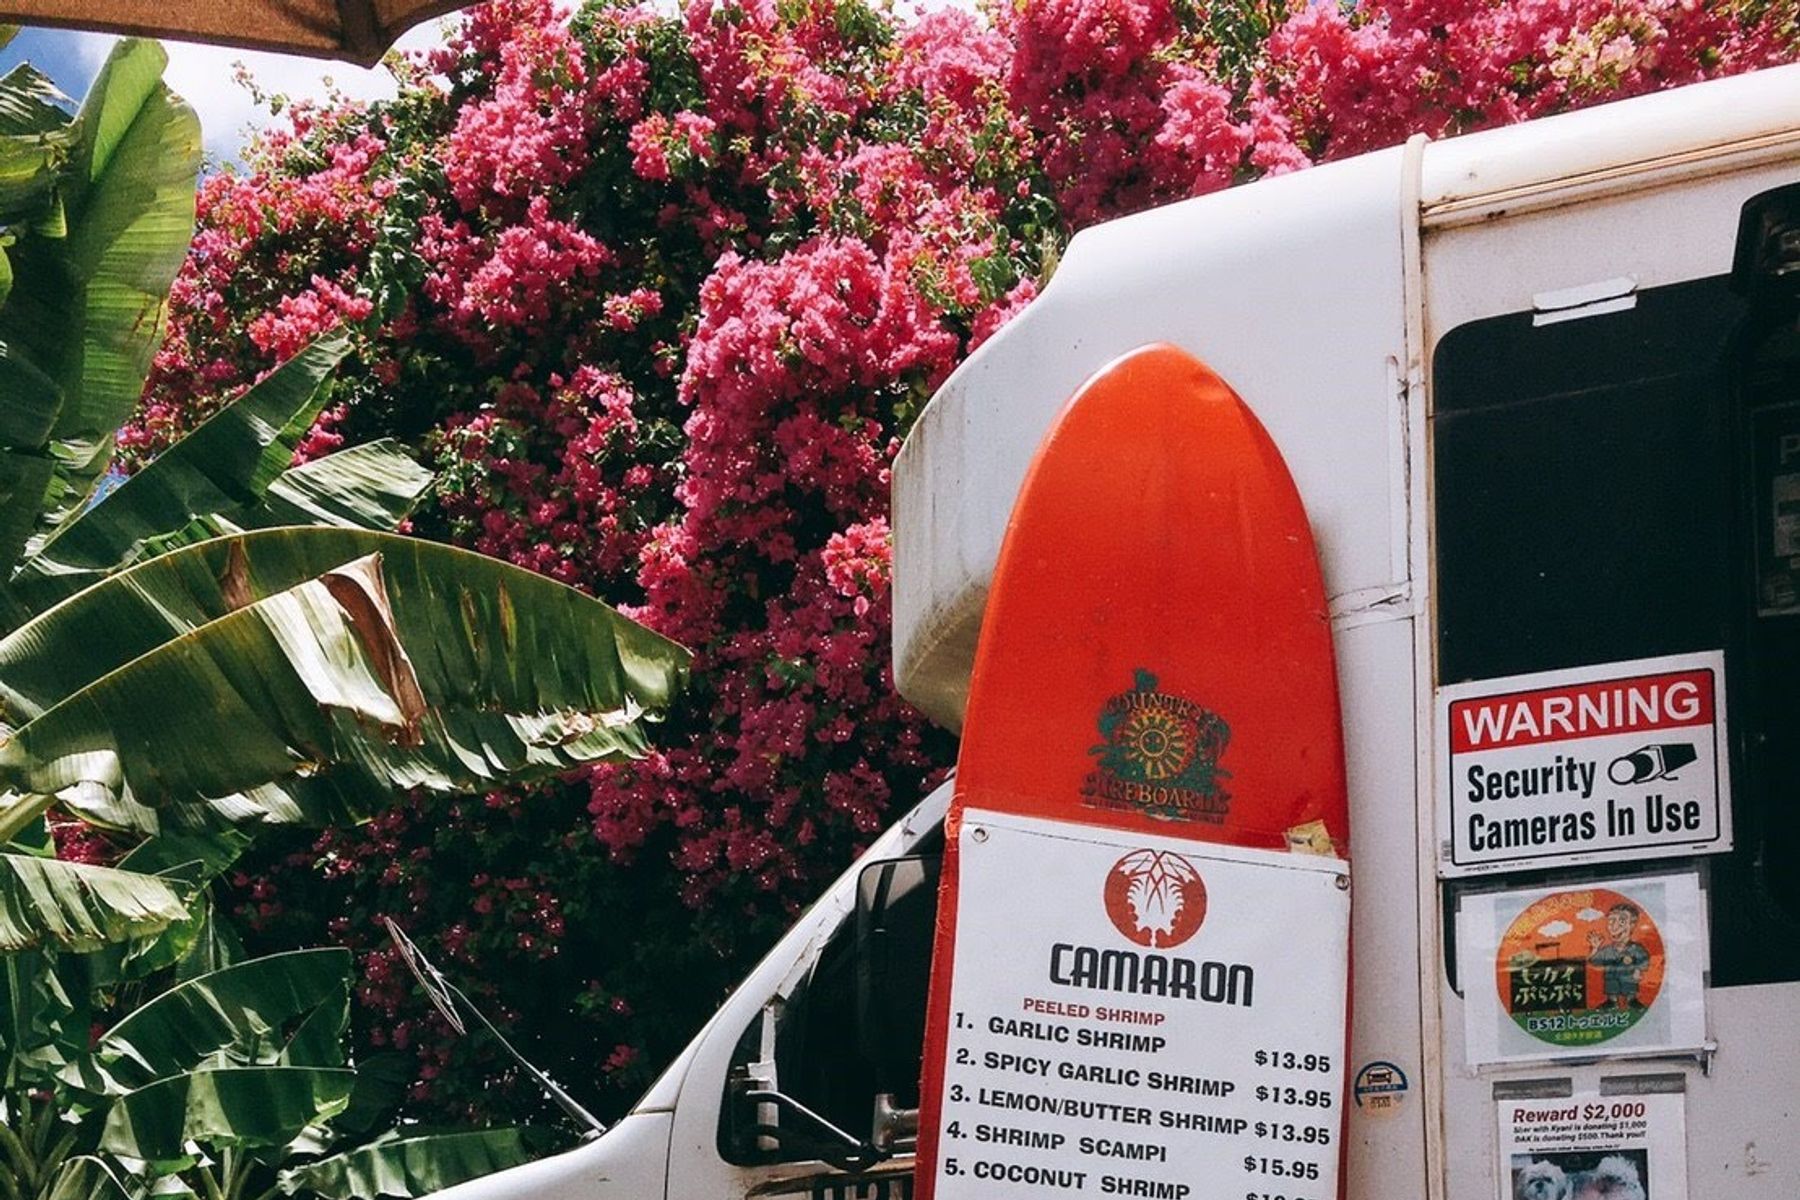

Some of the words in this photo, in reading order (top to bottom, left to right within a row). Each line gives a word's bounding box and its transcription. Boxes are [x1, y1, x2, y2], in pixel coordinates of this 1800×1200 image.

[1462, 681, 1700, 745] WARNING
[1467, 755, 1596, 803] Security
[1468, 808, 1596, 852] Cameras
[1607, 799, 1635, 838] In
[1646, 794, 1700, 834] Use
[1049, 942, 1254, 1006] CAMARON
[1023, 998, 1090, 1018] PEELED
[1095, 1007, 1166, 1027] SHRIMP
[1528, 1016, 1565, 1031] BS12
[954, 1012, 973, 1030] 1.
[988, 1016, 1069, 1043] GARLIC
[1077, 1028, 1166, 1053] SHRIMP
[1254, 1049, 1331, 1074] $13.95
[956, 1048, 976, 1067] 2.
[984, 1051, 1051, 1077] SPICY
[1058, 1062, 1140, 1088] GARLIC
[1147, 1072, 1235, 1099] SHRIMP
[1255, 1084, 1332, 1109] $13.95
[950, 1084, 971, 1103] 3.
[978, 1087, 1152, 1125] LEMON/BUTTER
[1159, 1110, 1248, 1136] SHRIMP
[1254, 1121, 1330, 1146] $13.95
[1512, 1105, 1579, 1123] Reward
[1583, 1102, 1646, 1121] $2,000
[1541, 1133, 1576, 1143] donating
[1583, 1122, 1618, 1132] donating
[944, 1158, 966, 1177] 5.
[973, 1161, 1087, 1191] COCONUT
[946, 1121, 967, 1139] 4.
[975, 1124, 1065, 1151] SHRIMP
[1079, 1137, 1167, 1163] SCAMPI
[1243, 1155, 1319, 1181] $15.95
